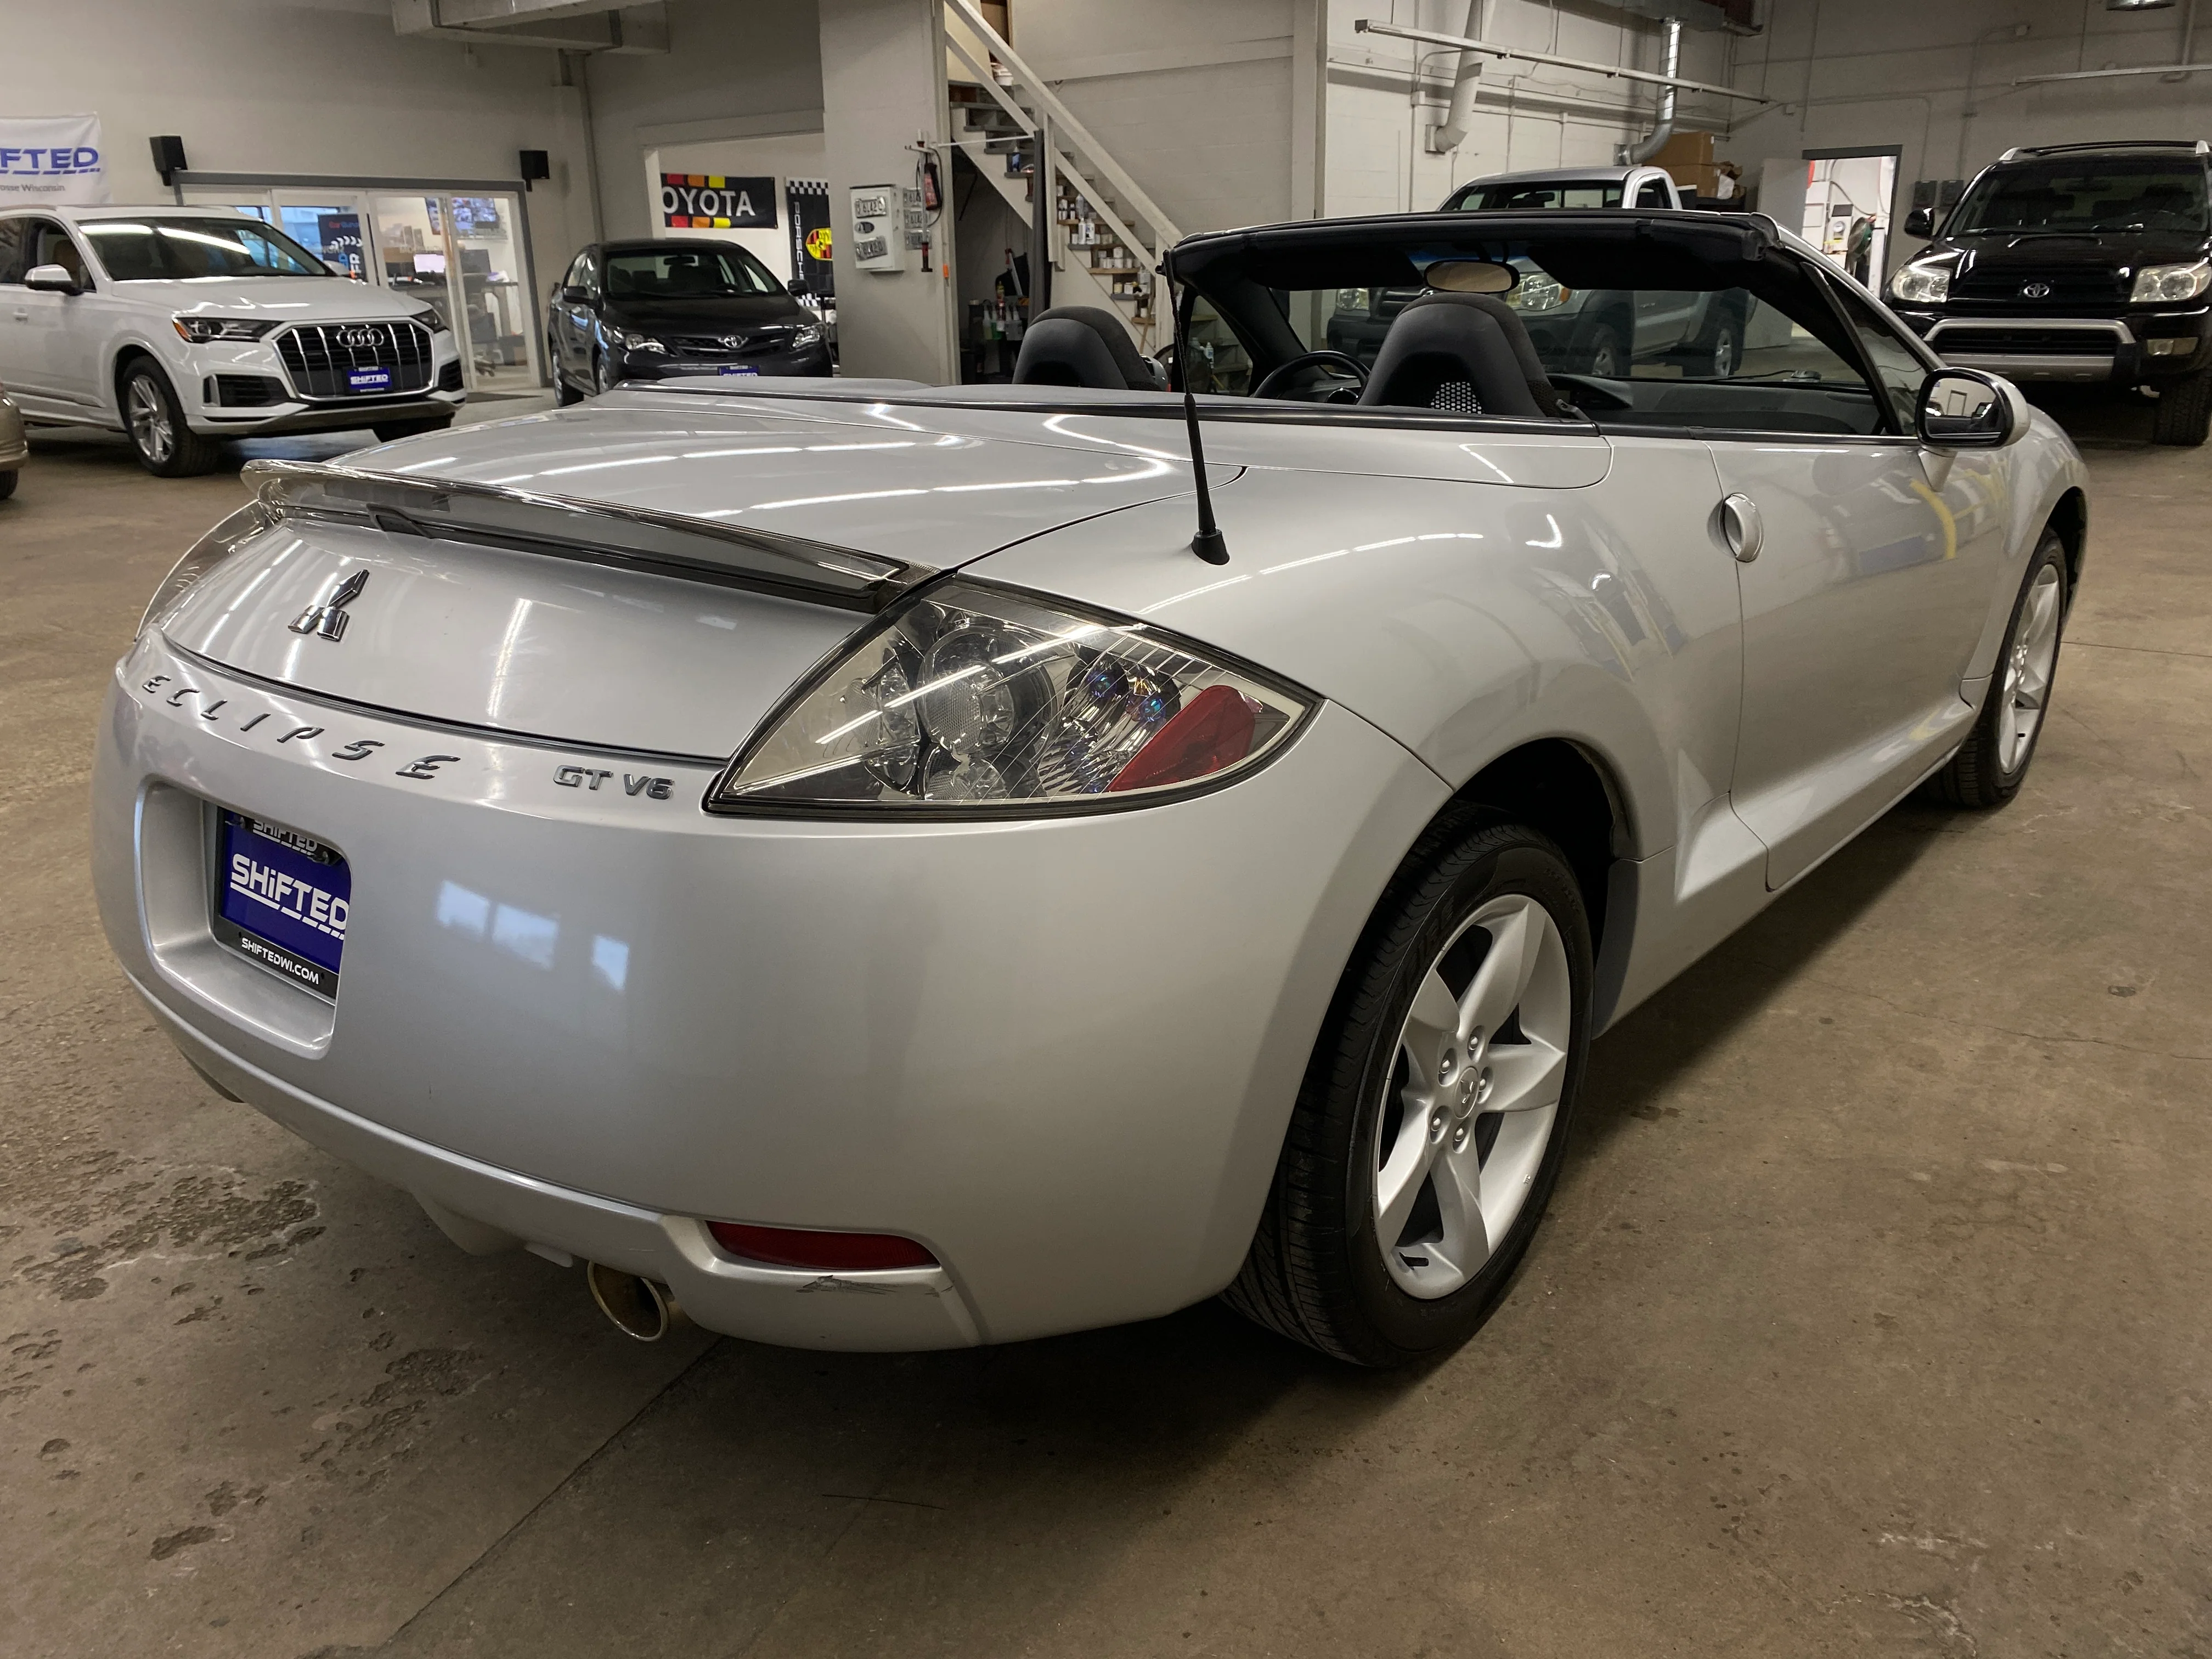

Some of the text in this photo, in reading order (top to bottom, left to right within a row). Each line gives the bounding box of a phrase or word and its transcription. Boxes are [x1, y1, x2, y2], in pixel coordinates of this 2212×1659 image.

[0, 147, 98, 168] FTED
[21, 183, 65, 191] Wisconsin
[662, 186, 756, 217] OYOTA
[142, 675, 461, 780] ECLIPSE
[553, 765, 675, 800] GT V6
[241, 937, 319, 984] SHIFTEDWI.COM
